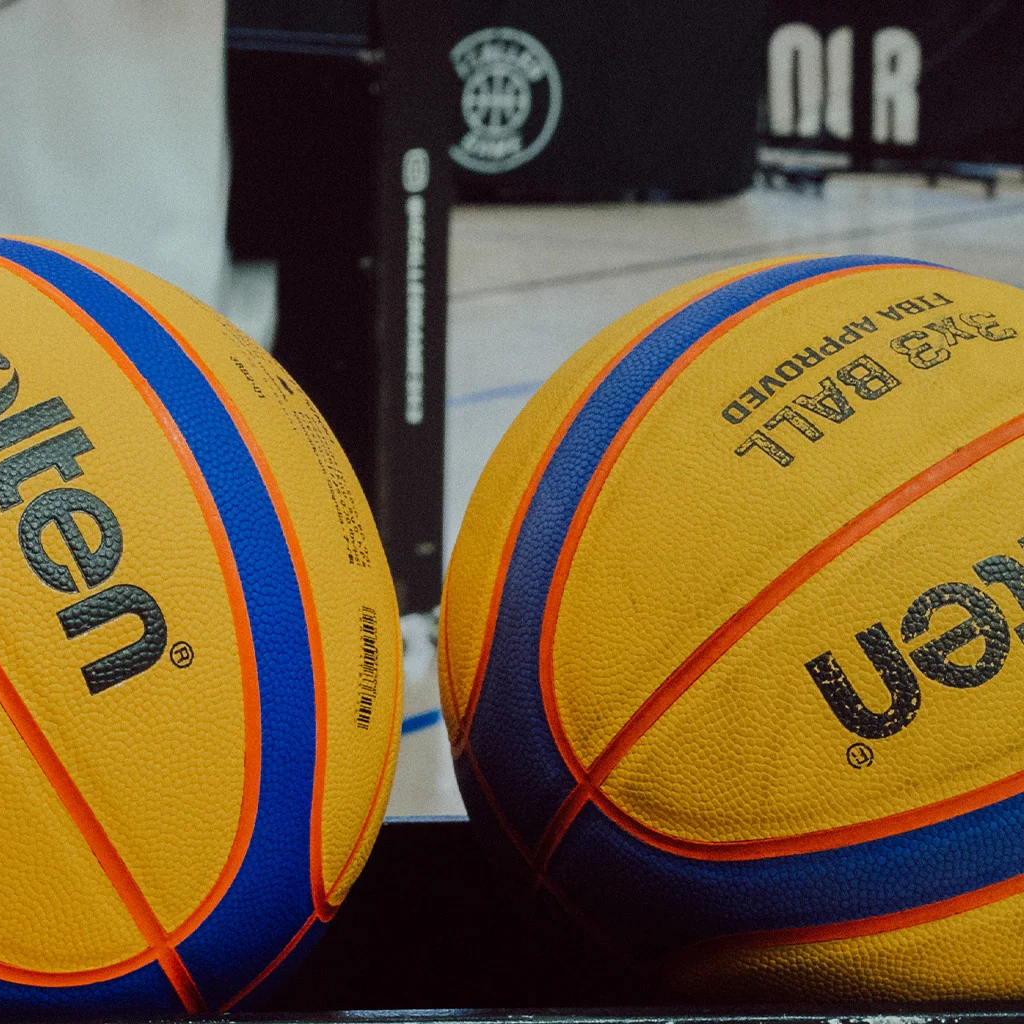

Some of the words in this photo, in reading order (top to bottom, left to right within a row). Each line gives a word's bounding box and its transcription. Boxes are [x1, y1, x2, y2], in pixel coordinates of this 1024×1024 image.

[876, 292, 954, 322] FIBA
[722, 314, 875, 425] APPROVED
[734, 354, 901, 467] BALL
